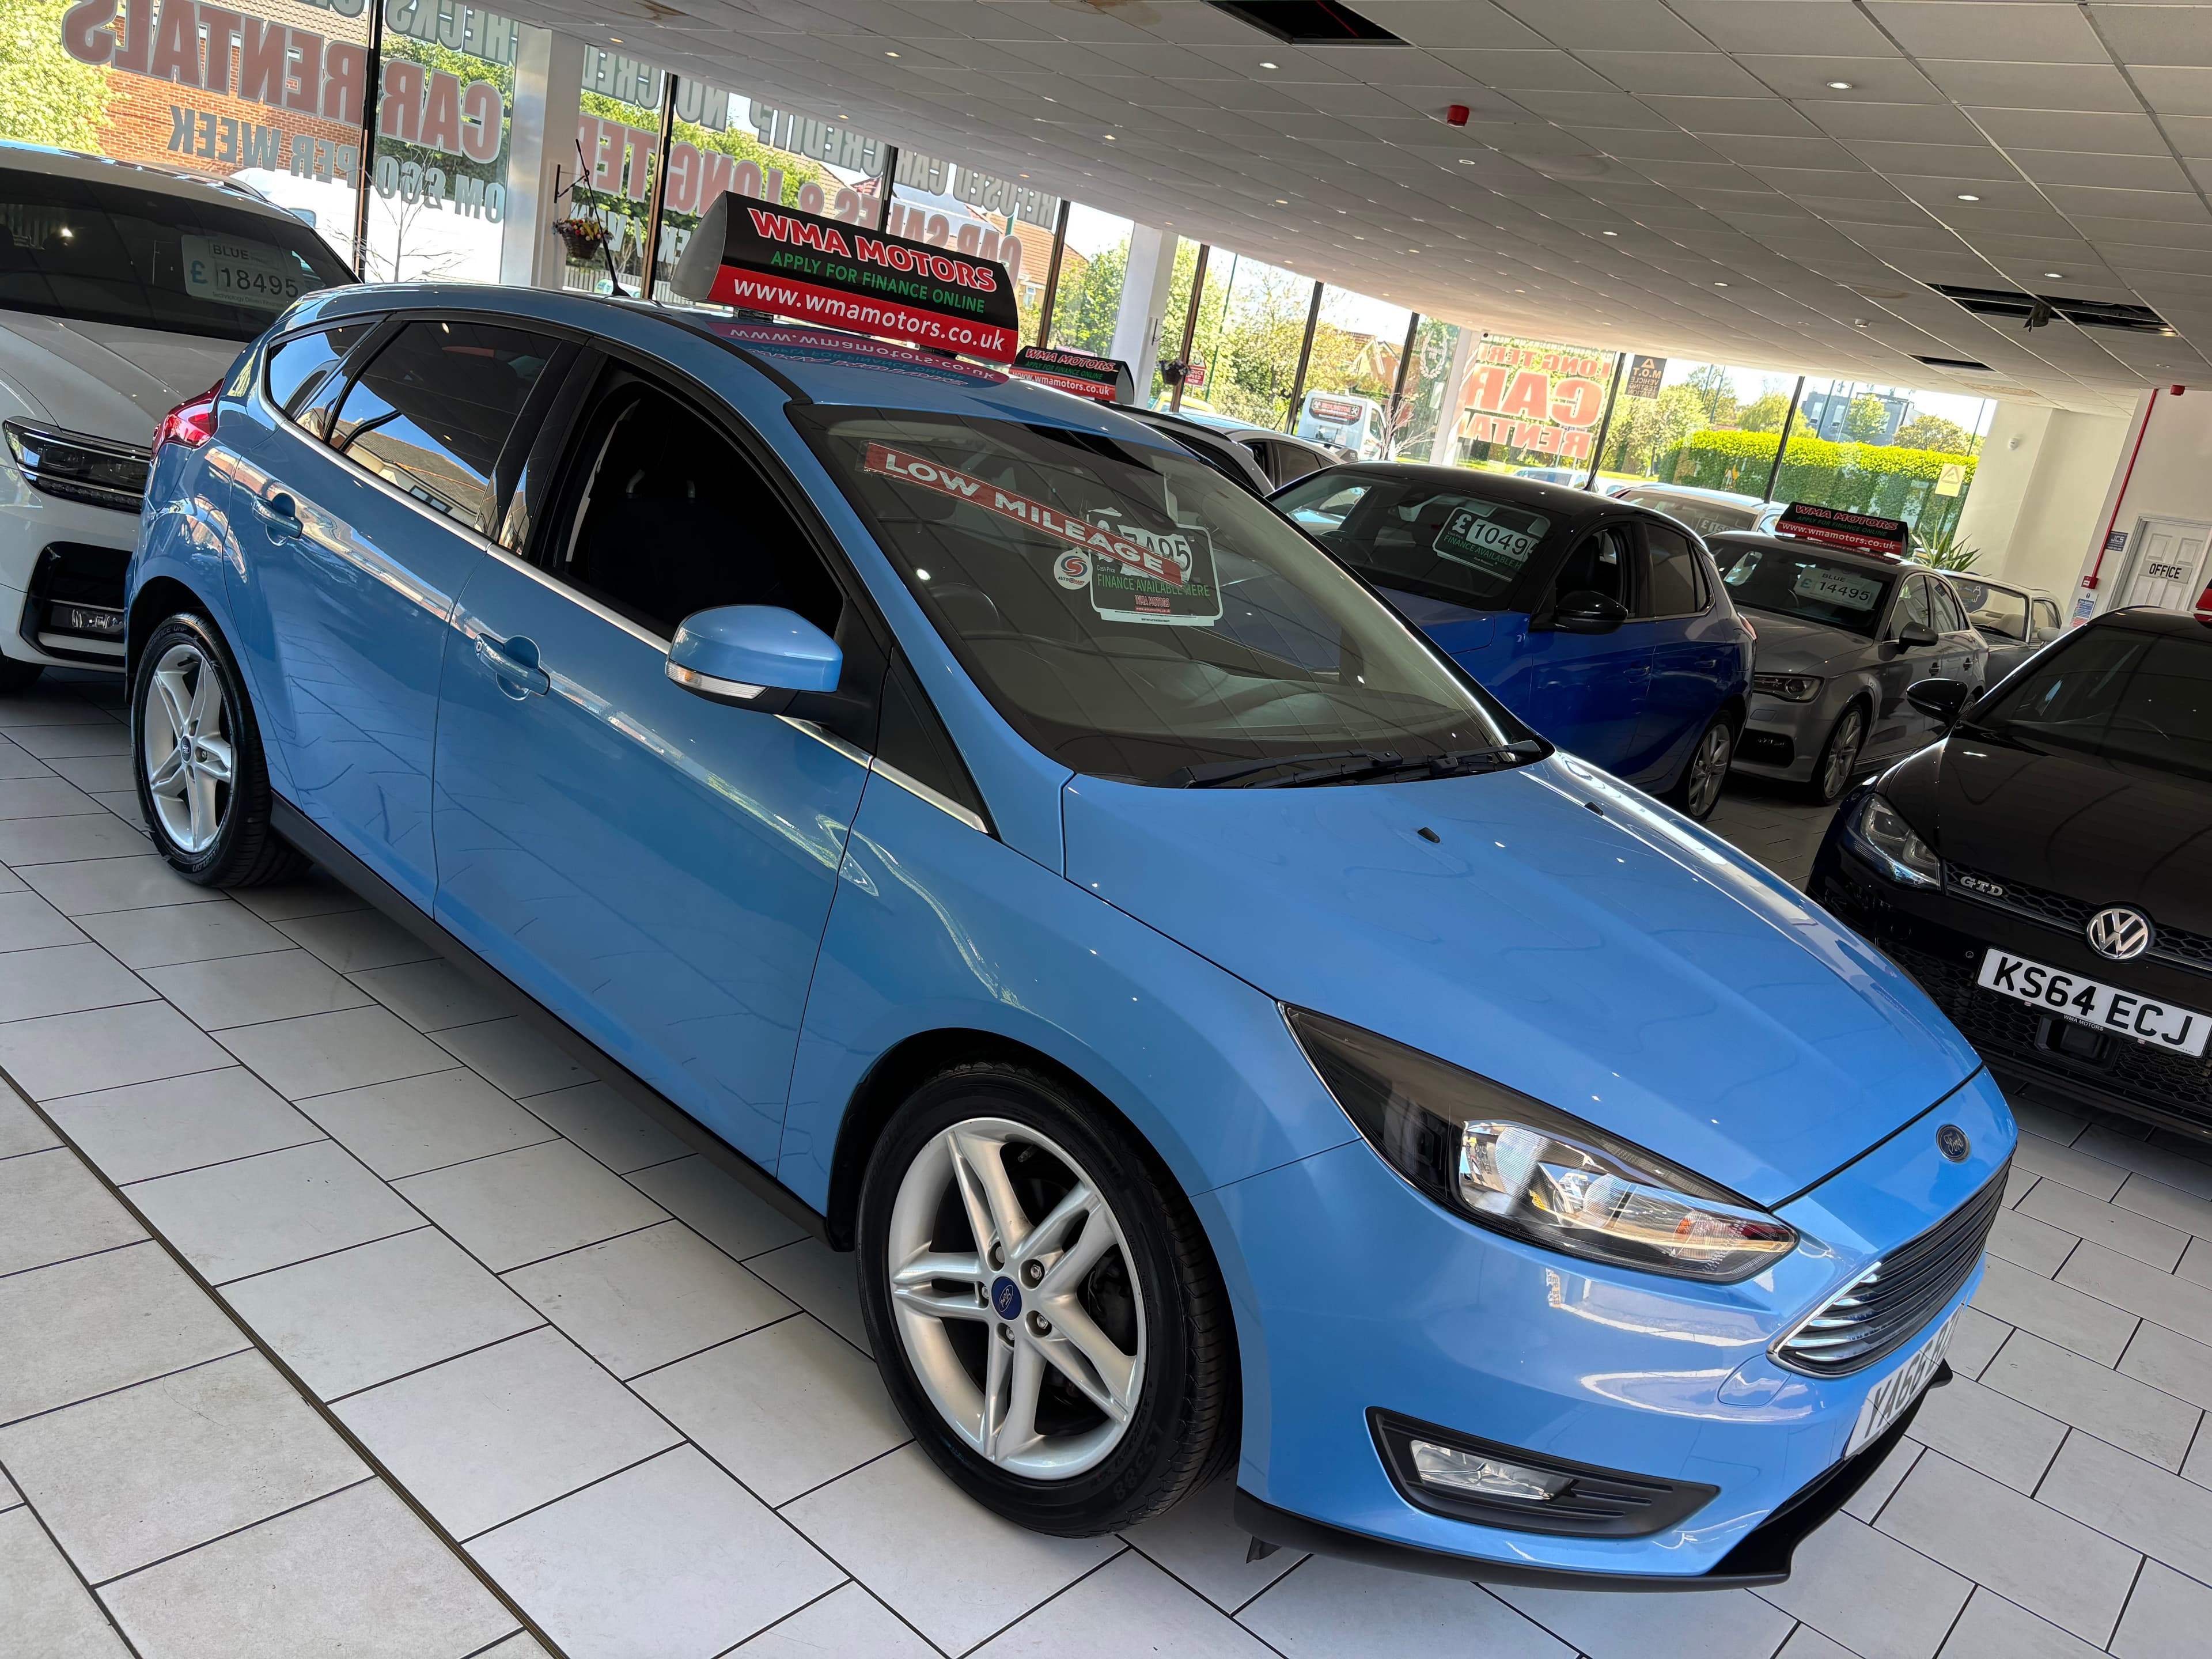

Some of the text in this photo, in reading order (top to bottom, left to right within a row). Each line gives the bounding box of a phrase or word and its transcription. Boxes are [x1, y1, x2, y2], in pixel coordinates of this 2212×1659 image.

[213, 244, 249, 259] BLUE
[748, 207, 998, 293] WMA MOTORS
[191, 260, 299, 298] £ 18495
[771, 250, 985, 313] APPLY FOR FINANCE ONLINE
[733, 278, 1005, 352] www.wmamotors.co.uk
[1025, 348, 1116, 372] WMA MOTORS
[1043, 363, 1055, 371] FOR
[1055, 365, 1080, 376] FINANCE
[1081, 370, 1104, 380] ONLINE
[1012, 372, 1110, 396] www.wmamotors.co.uk
[885, 453, 1165, 575] LOW MILEAGE
[1452, 514, 1472, 534] £
[1796, 505, 1899, 531] WMA MOTORS
[1782, 523, 1896, 550] www.wmamotors.co.uk
[1832, 521, 1860, 532] FINANCE
[1862, 527, 1888, 537] ONLINE
[1444, 535, 1475, 552] FINANCE
[1475, 547, 1515, 568] AVAILABLE
[1821, 573, 1846, 582] BLUE
[2149, 563, 2182, 579] OFFICE
[1097, 574, 1211, 597] FINANCE AVAILABLE HERE
[1801, 578, 1813, 589] £
[1820, 582, 1871, 601] 14495
[1960, 876, 2003, 896] GTD
[1993, 956, 2194, 1047] KS64 ECJ
[2063, 1014, 2104, 1032] WMA MOTORS
[1000, 1288, 1012, 1309] Ford
